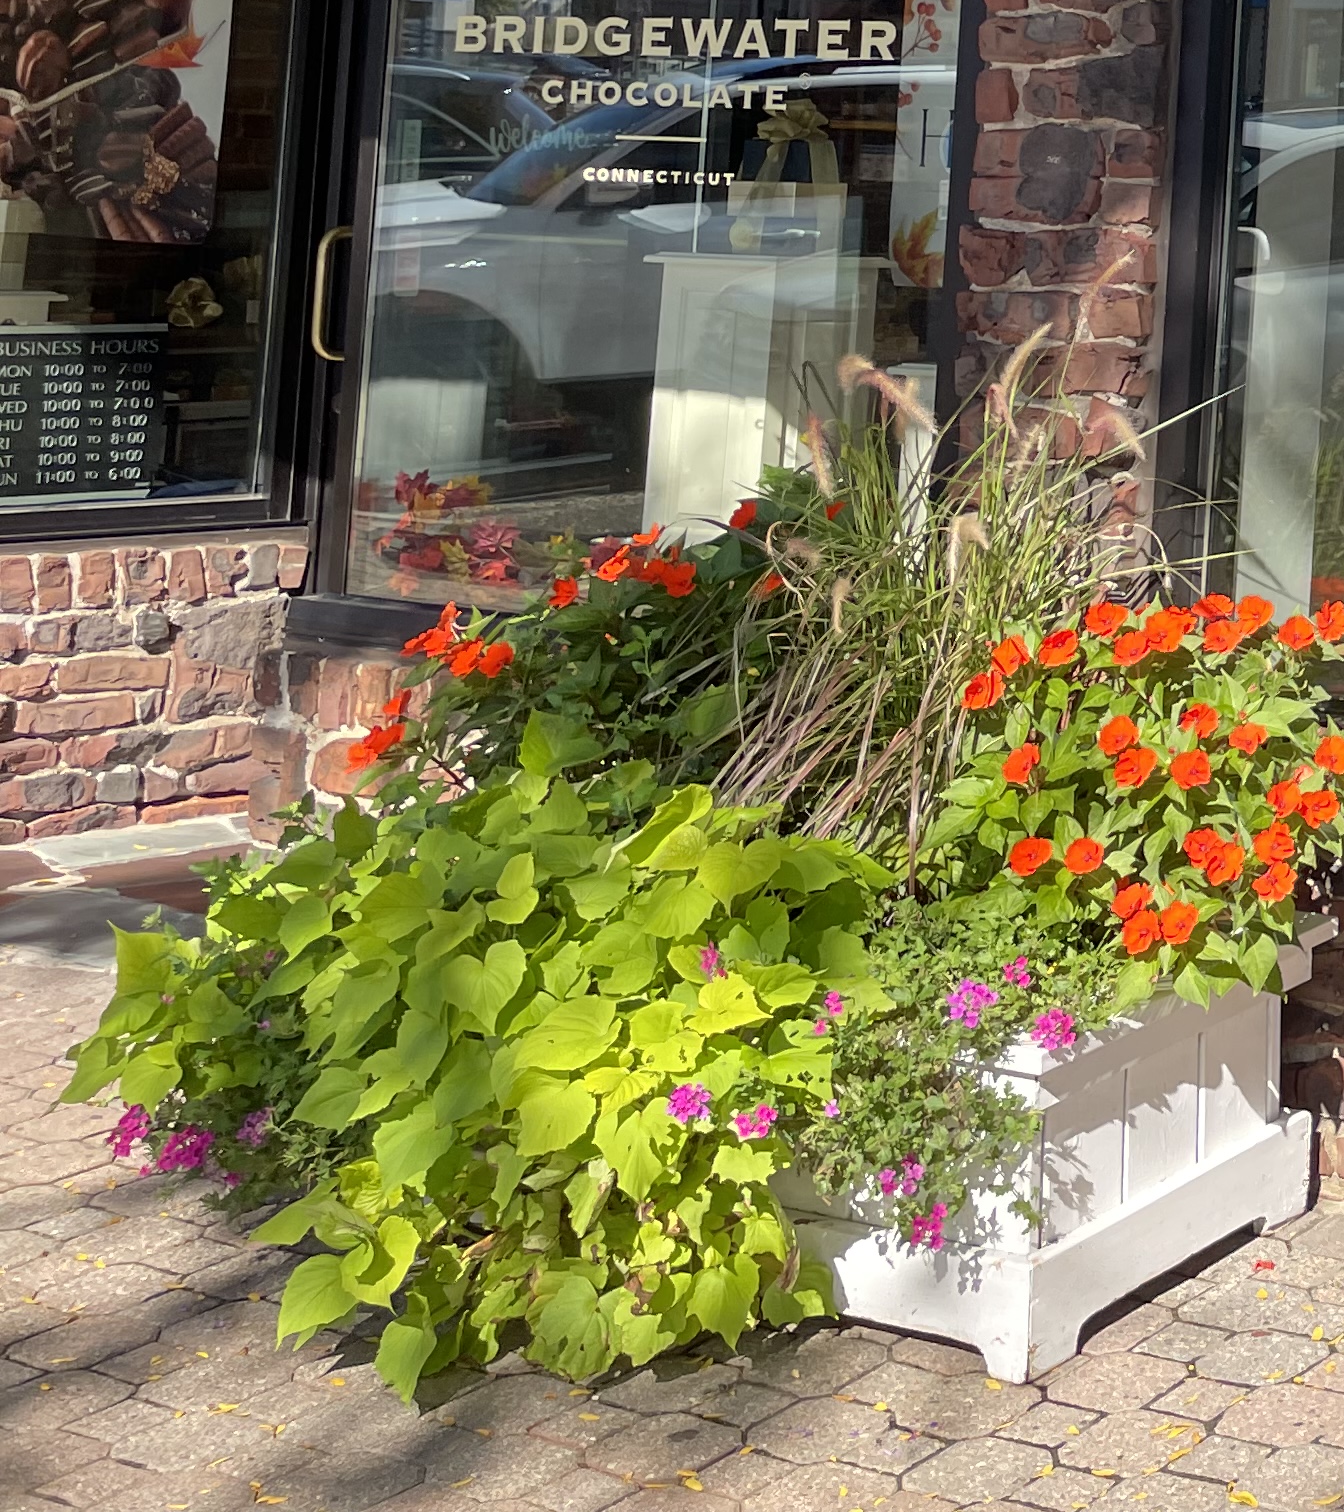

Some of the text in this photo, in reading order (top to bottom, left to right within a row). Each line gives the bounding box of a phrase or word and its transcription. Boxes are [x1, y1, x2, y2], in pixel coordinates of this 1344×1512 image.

[453, 14, 898, 62] BRIDGEWATER
[541, 79, 788, 111] CHOCOLATE
[582, 167, 735, 186] CONNECTICUT
[90, 338, 160, 355] HOURS
[44, 363, 85, 376] 10:00
[93, 364, 107, 373] TO
[42, 381, 83, 395] 10:00
[90, 382, 105, 391] TO
[42, 399, 82, 412] 10:00
[89, 399, 104, 409] TO
[40, 416, 80, 430] 10:00
[88, 417, 103, 427] TO
[38, 434, 78, 448] 10:00
[87, 435, 101, 444] TO
[37, 452, 77, 466] 10:00
[85, 452, 100, 462] TO
[35, 469, 76, 484] 11:00
[83, 470, 98, 480] TO
